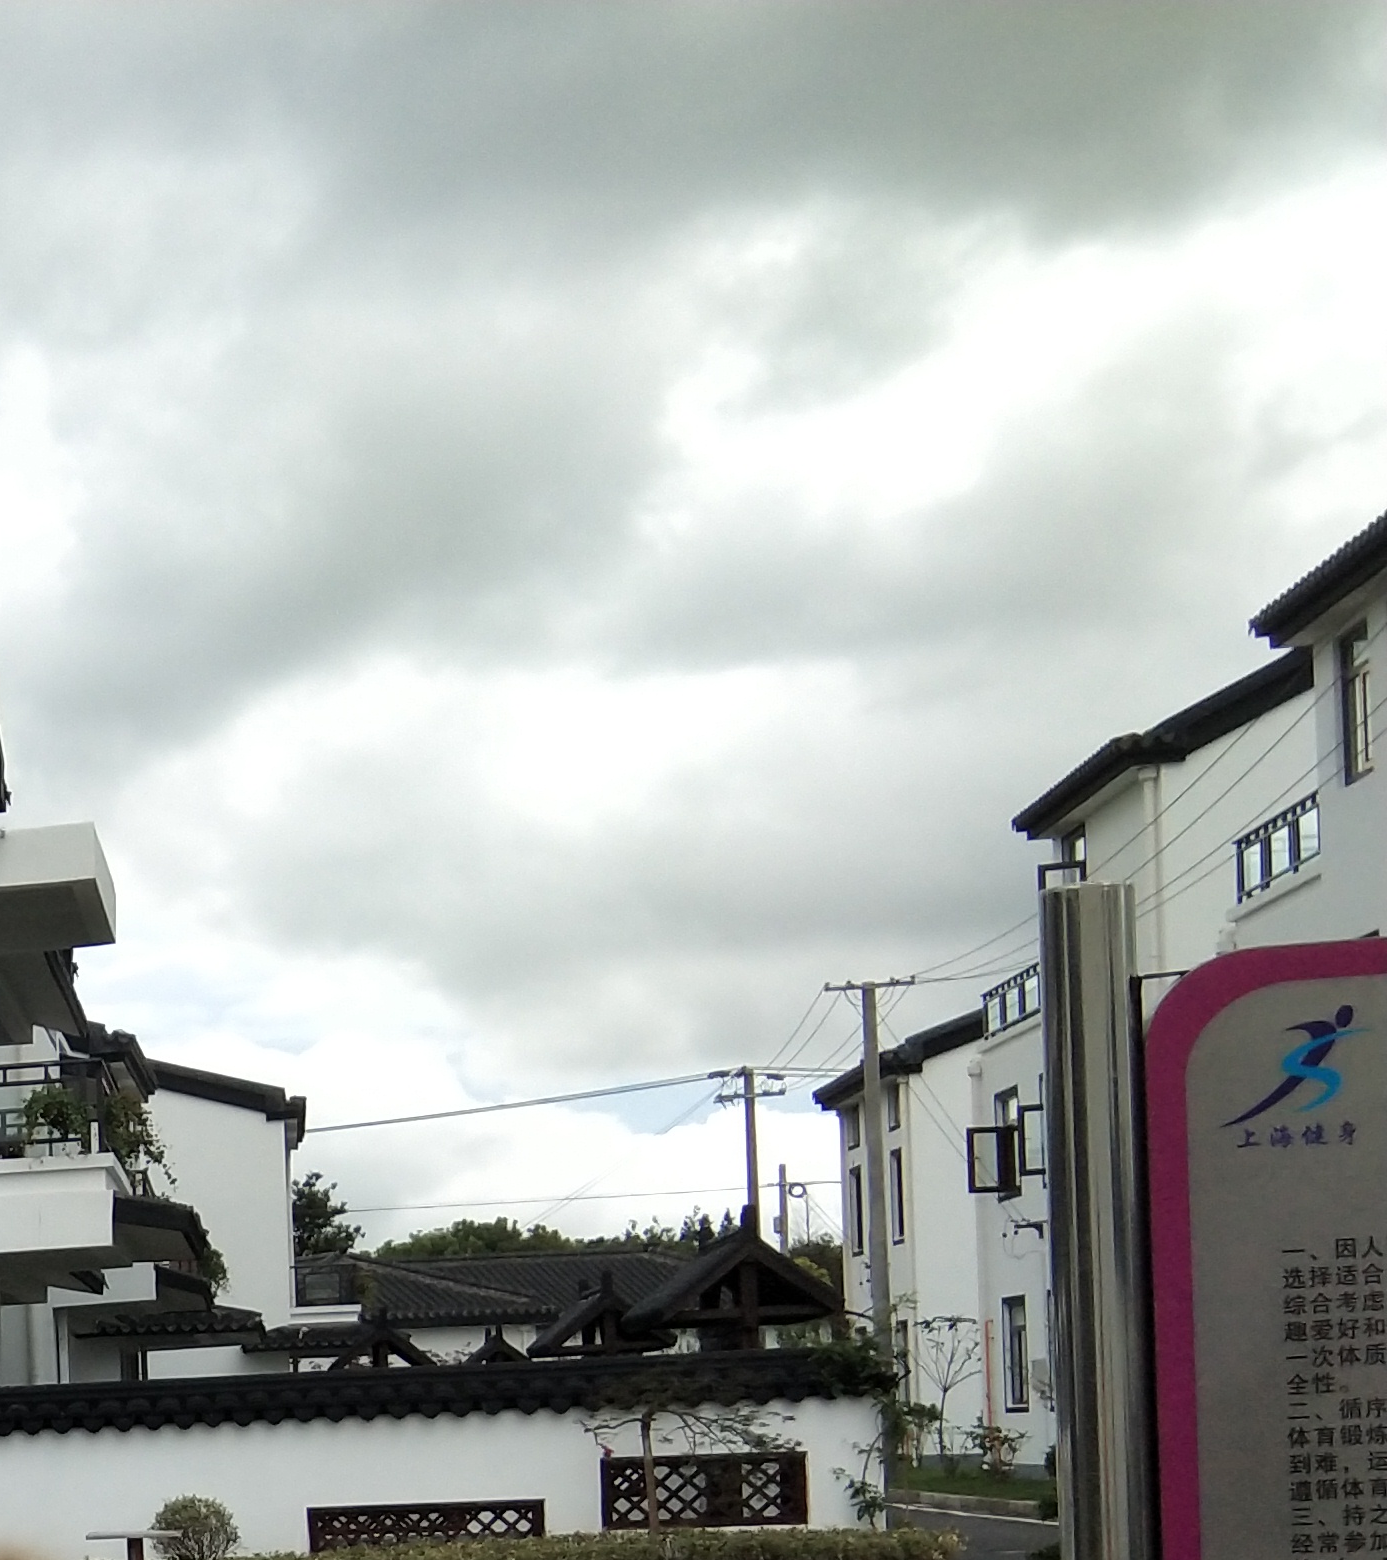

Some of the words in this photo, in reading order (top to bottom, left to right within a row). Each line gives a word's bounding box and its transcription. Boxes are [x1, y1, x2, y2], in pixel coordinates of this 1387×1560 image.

[1236, 1120, 1358, 1149] 上海健身
[1281, 1236, 1384, 1260] 一、因人
[1282, 1264, 1384, 1289] 选择适合
[1283, 1291, 1385, 1315] 综合考虑
[1284, 1317, 1386, 1341] 趣爱好和
[1286, 1344, 1386, 1368] 一次体质
[1287, 1371, 1349, 1395] 全性。
